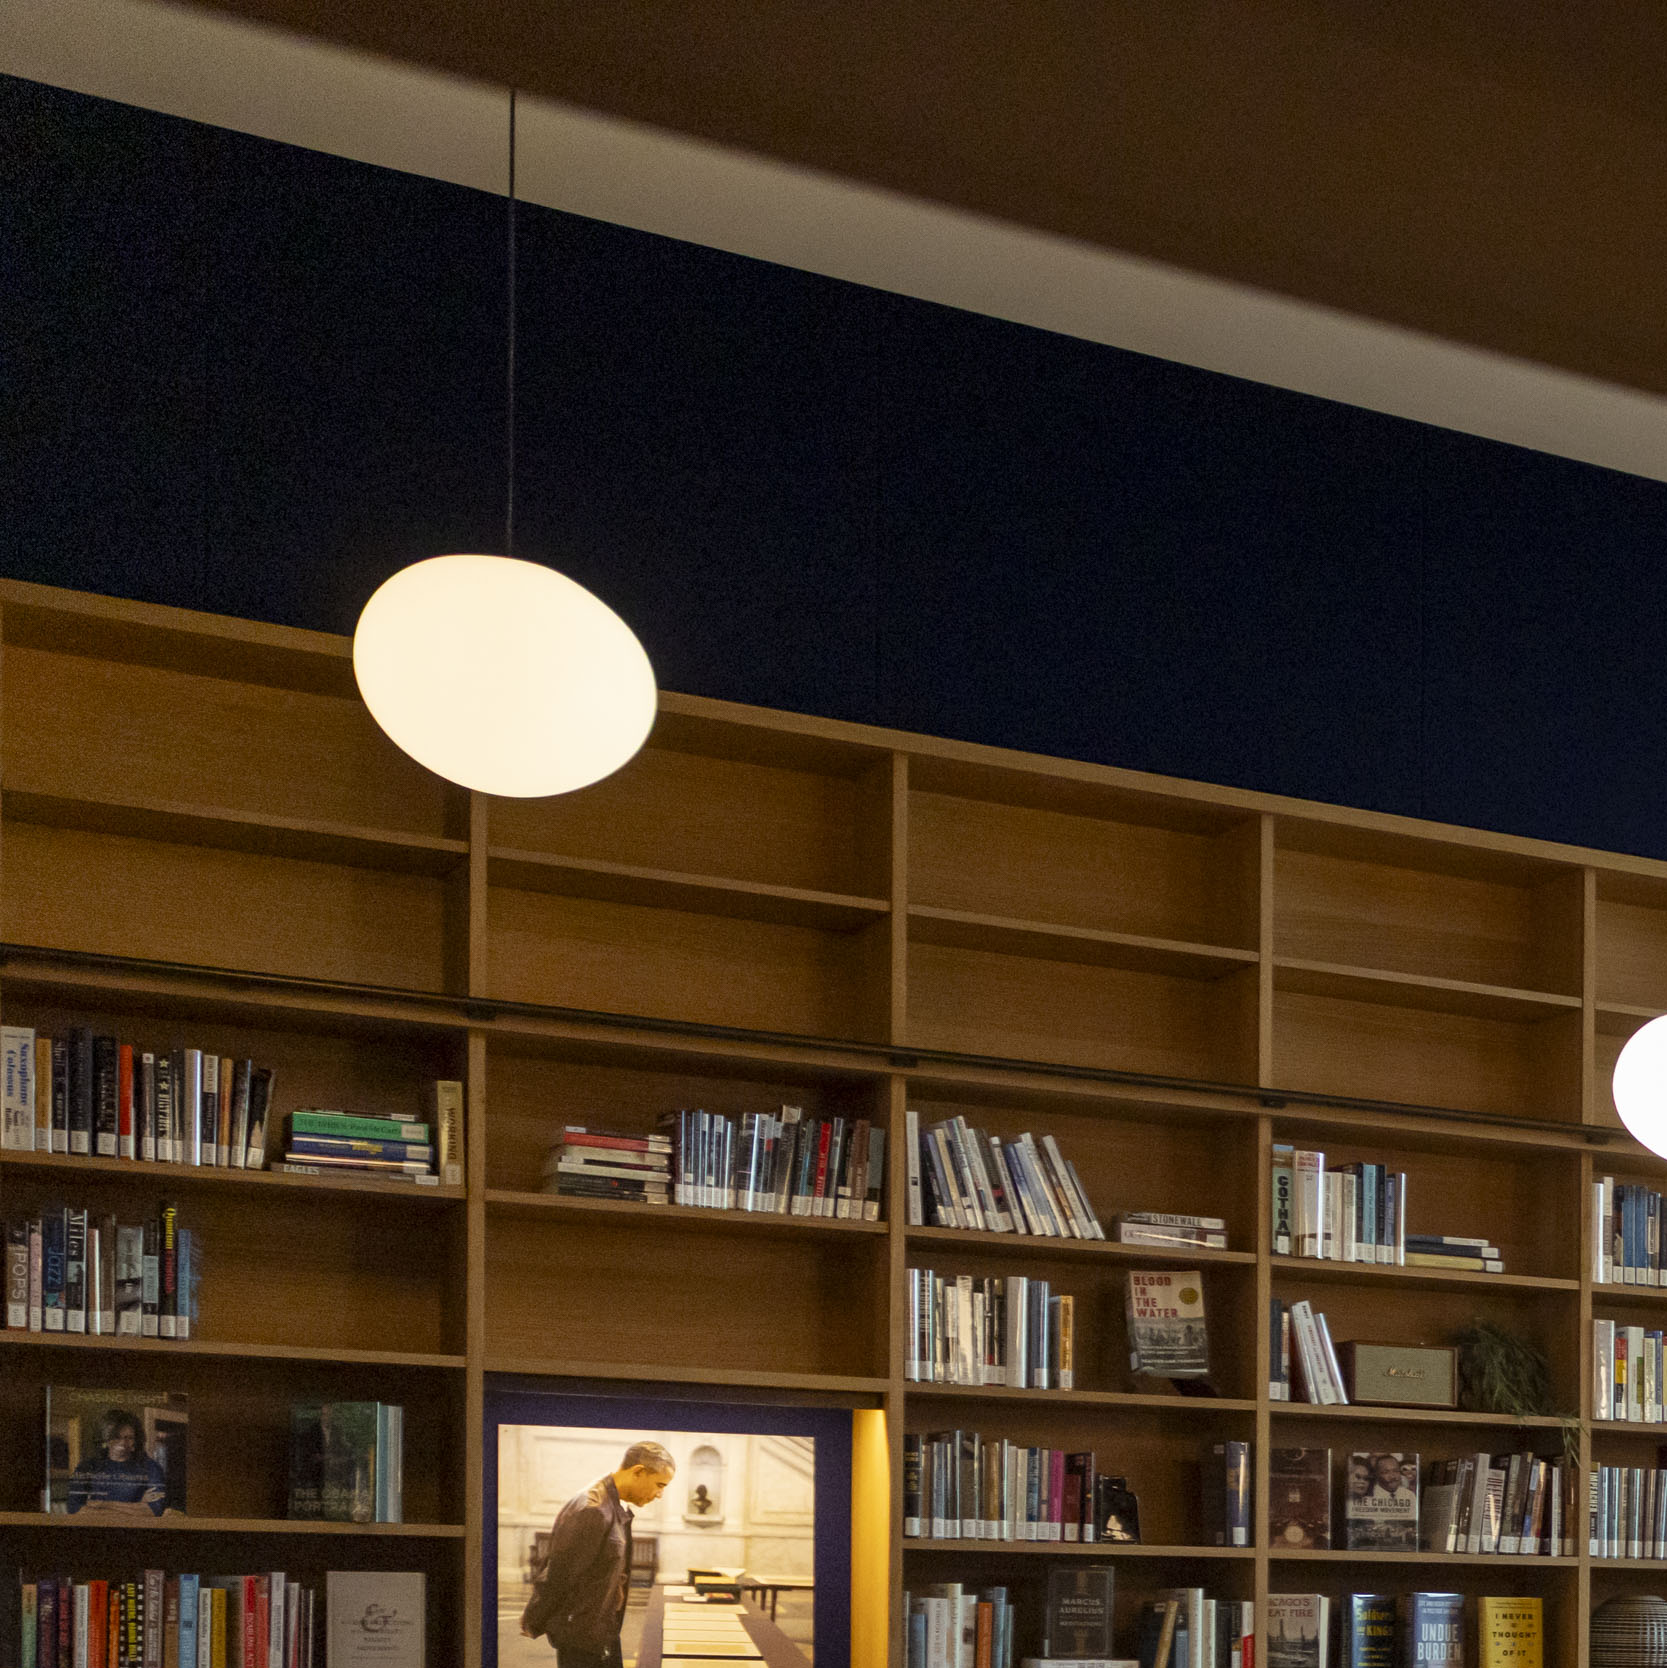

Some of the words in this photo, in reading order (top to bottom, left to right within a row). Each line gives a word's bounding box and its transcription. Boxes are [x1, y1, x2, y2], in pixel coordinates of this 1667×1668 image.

[69, 1213, 85, 1257] Miles
[47, 1247, 65, 1286] Jazz
[11, 1251, 27, 1300] POPS
[1133, 1275, 1172, 1287] BLOOD
[1134, 1287, 1147, 1297] IN
[1135, 1297, 1158, 1308] THE
[1136, 1308, 1178, 1319] WATER
[1373, 1497, 1411, 1508] CHICAGO
[1500, 1613, 1534, 1621] NEVER
[1421, 1623, 1459, 1642] UNDUE
[1491, 1631, 1537, 1639] THOUGHT
[1417, 1642, 1462, 1661] BURDEN
[1502, 1649, 1515, 1657] OF
[1517, 1649, 1527, 1657] IT
